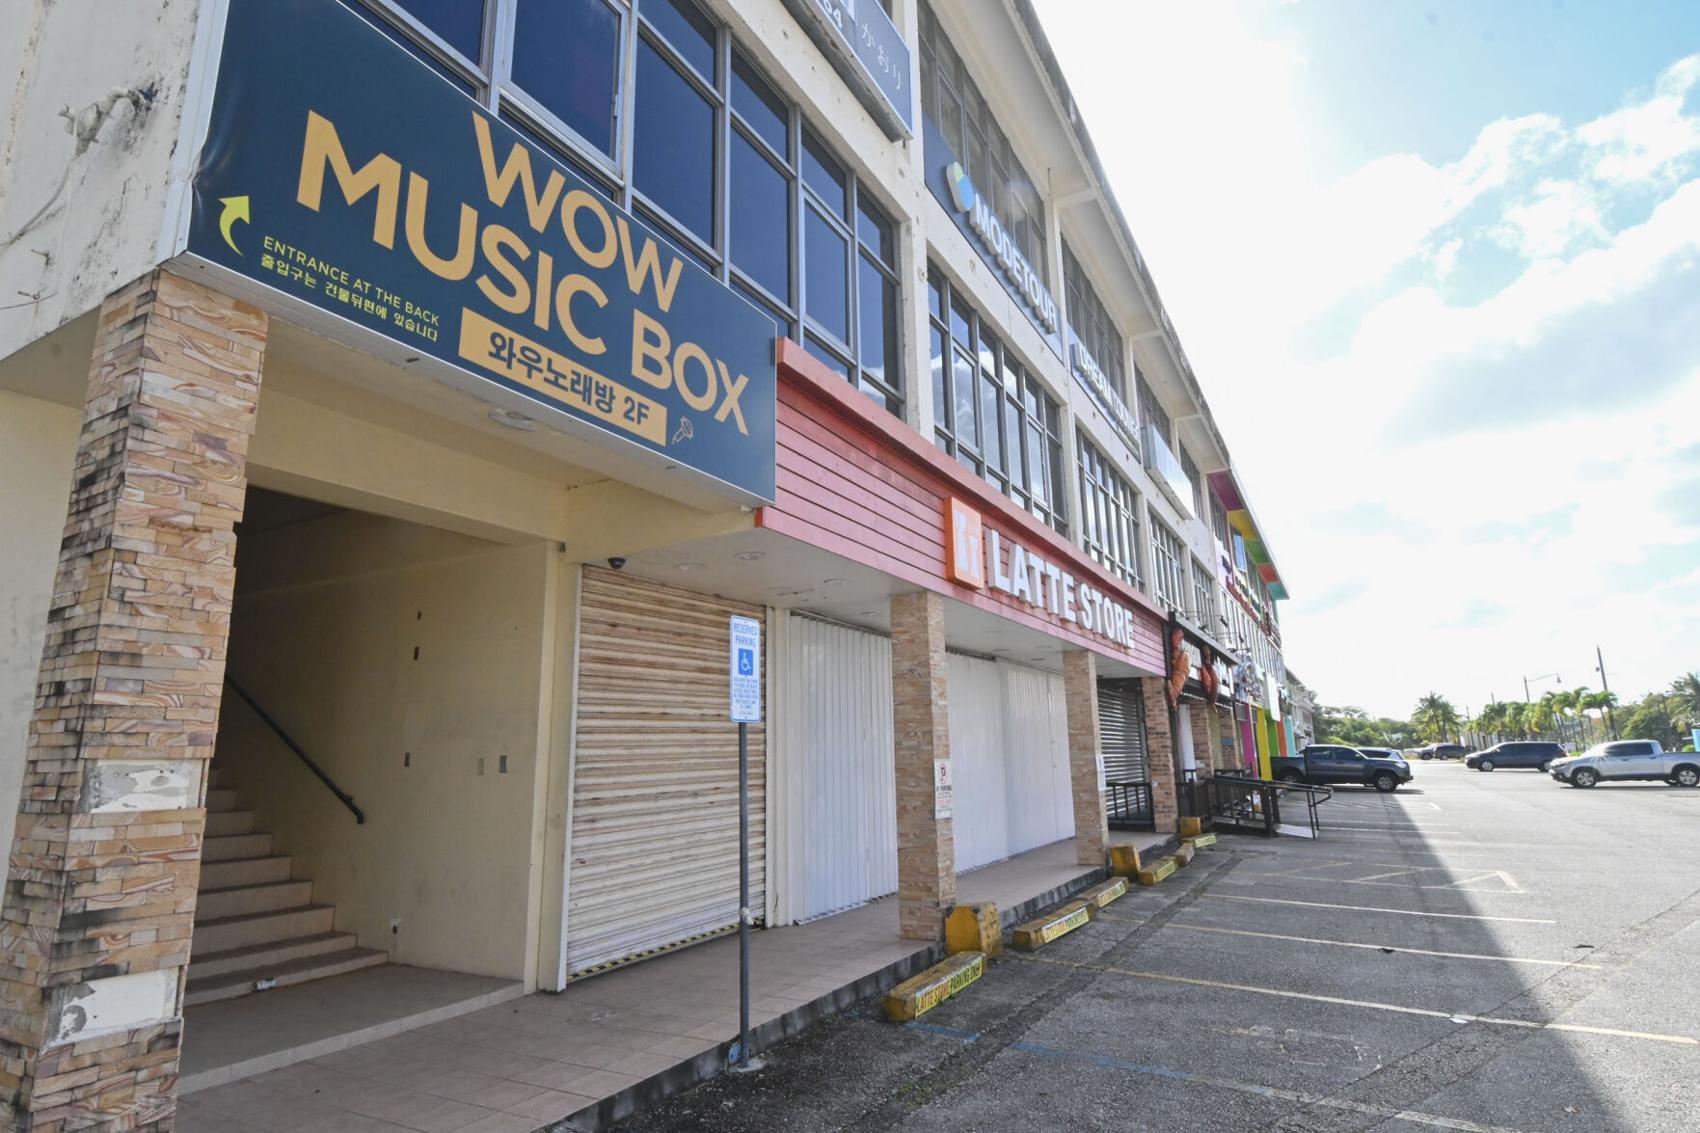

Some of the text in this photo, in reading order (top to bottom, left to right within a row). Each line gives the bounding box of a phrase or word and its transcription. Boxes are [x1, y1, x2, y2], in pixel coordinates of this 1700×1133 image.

[862, 24, 901, 90] かおり
[472, 110, 683, 313] WOW
[261, 253, 317, 289] 출입구는
[393, 311, 439, 342] 있습니다
[263, 235, 440, 326] ENTRANCE AT THE BACK
[297, 109, 750, 437] MUSIC BOX
[970, 192, 1057, 333] MODETOUR
[488, 330, 650, 426] 와우노래방 2F
[733, 623, 758, 636] RESERVED
[987, 529, 1077, 622] LATTE
[1079, 582, 1136, 649] STORE
[735, 635, 757, 648] PARKING
